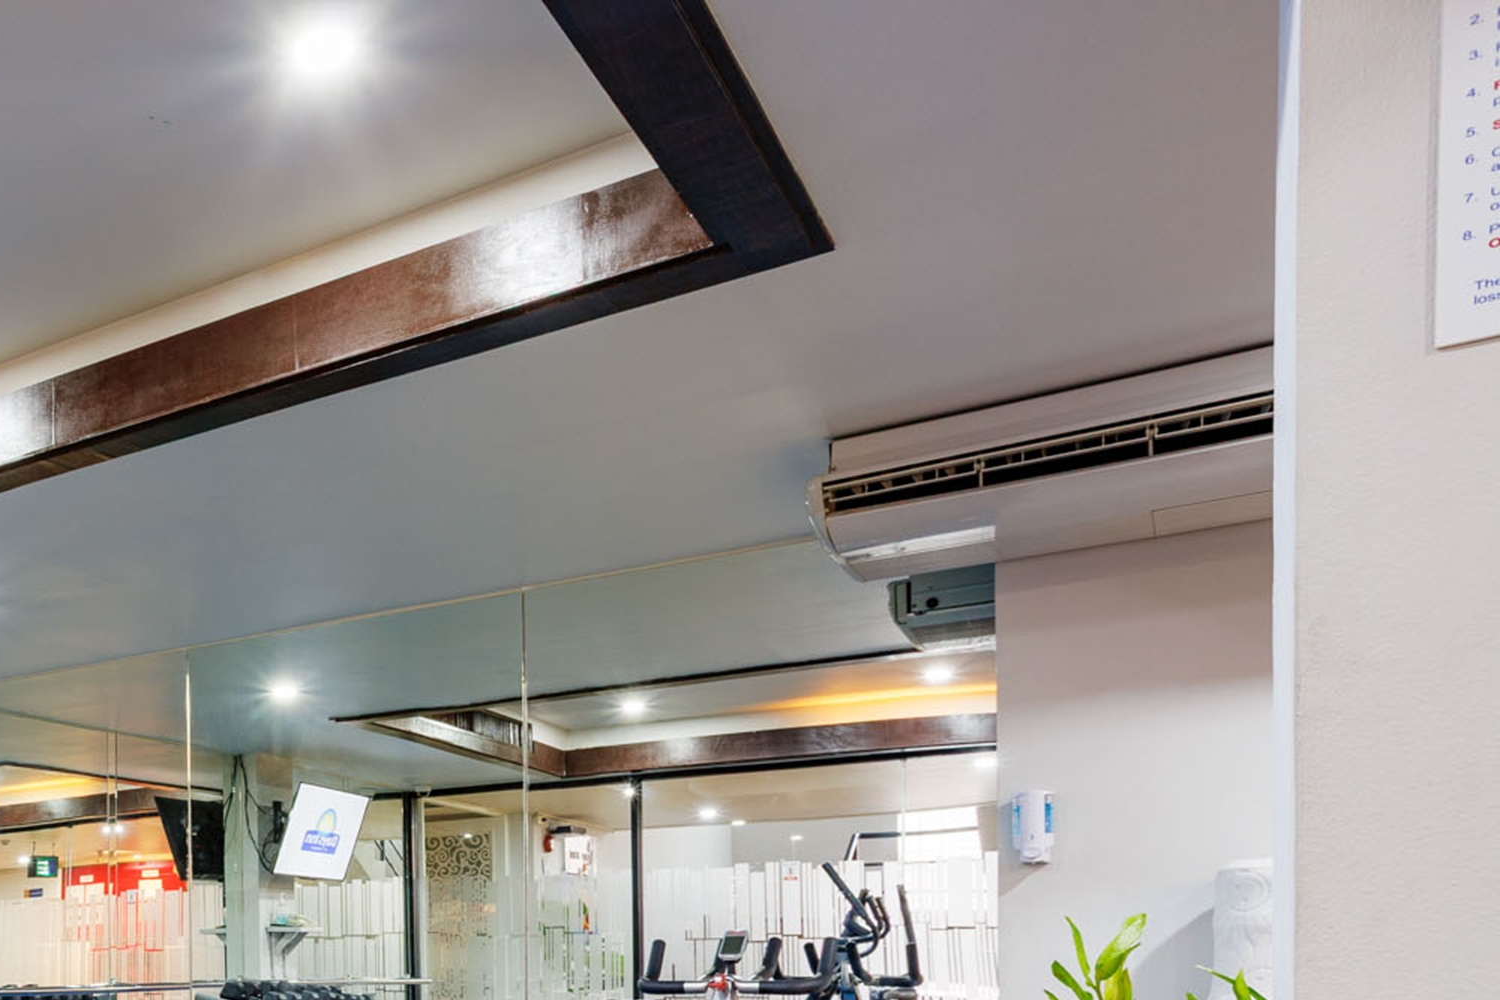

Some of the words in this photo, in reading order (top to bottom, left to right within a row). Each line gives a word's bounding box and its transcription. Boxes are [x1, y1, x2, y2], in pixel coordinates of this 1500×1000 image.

[1465, 154, 1479, 165] 6.
[1465, 192, 1479, 203] 7.
[1463, 230, 1477, 241] 8.
